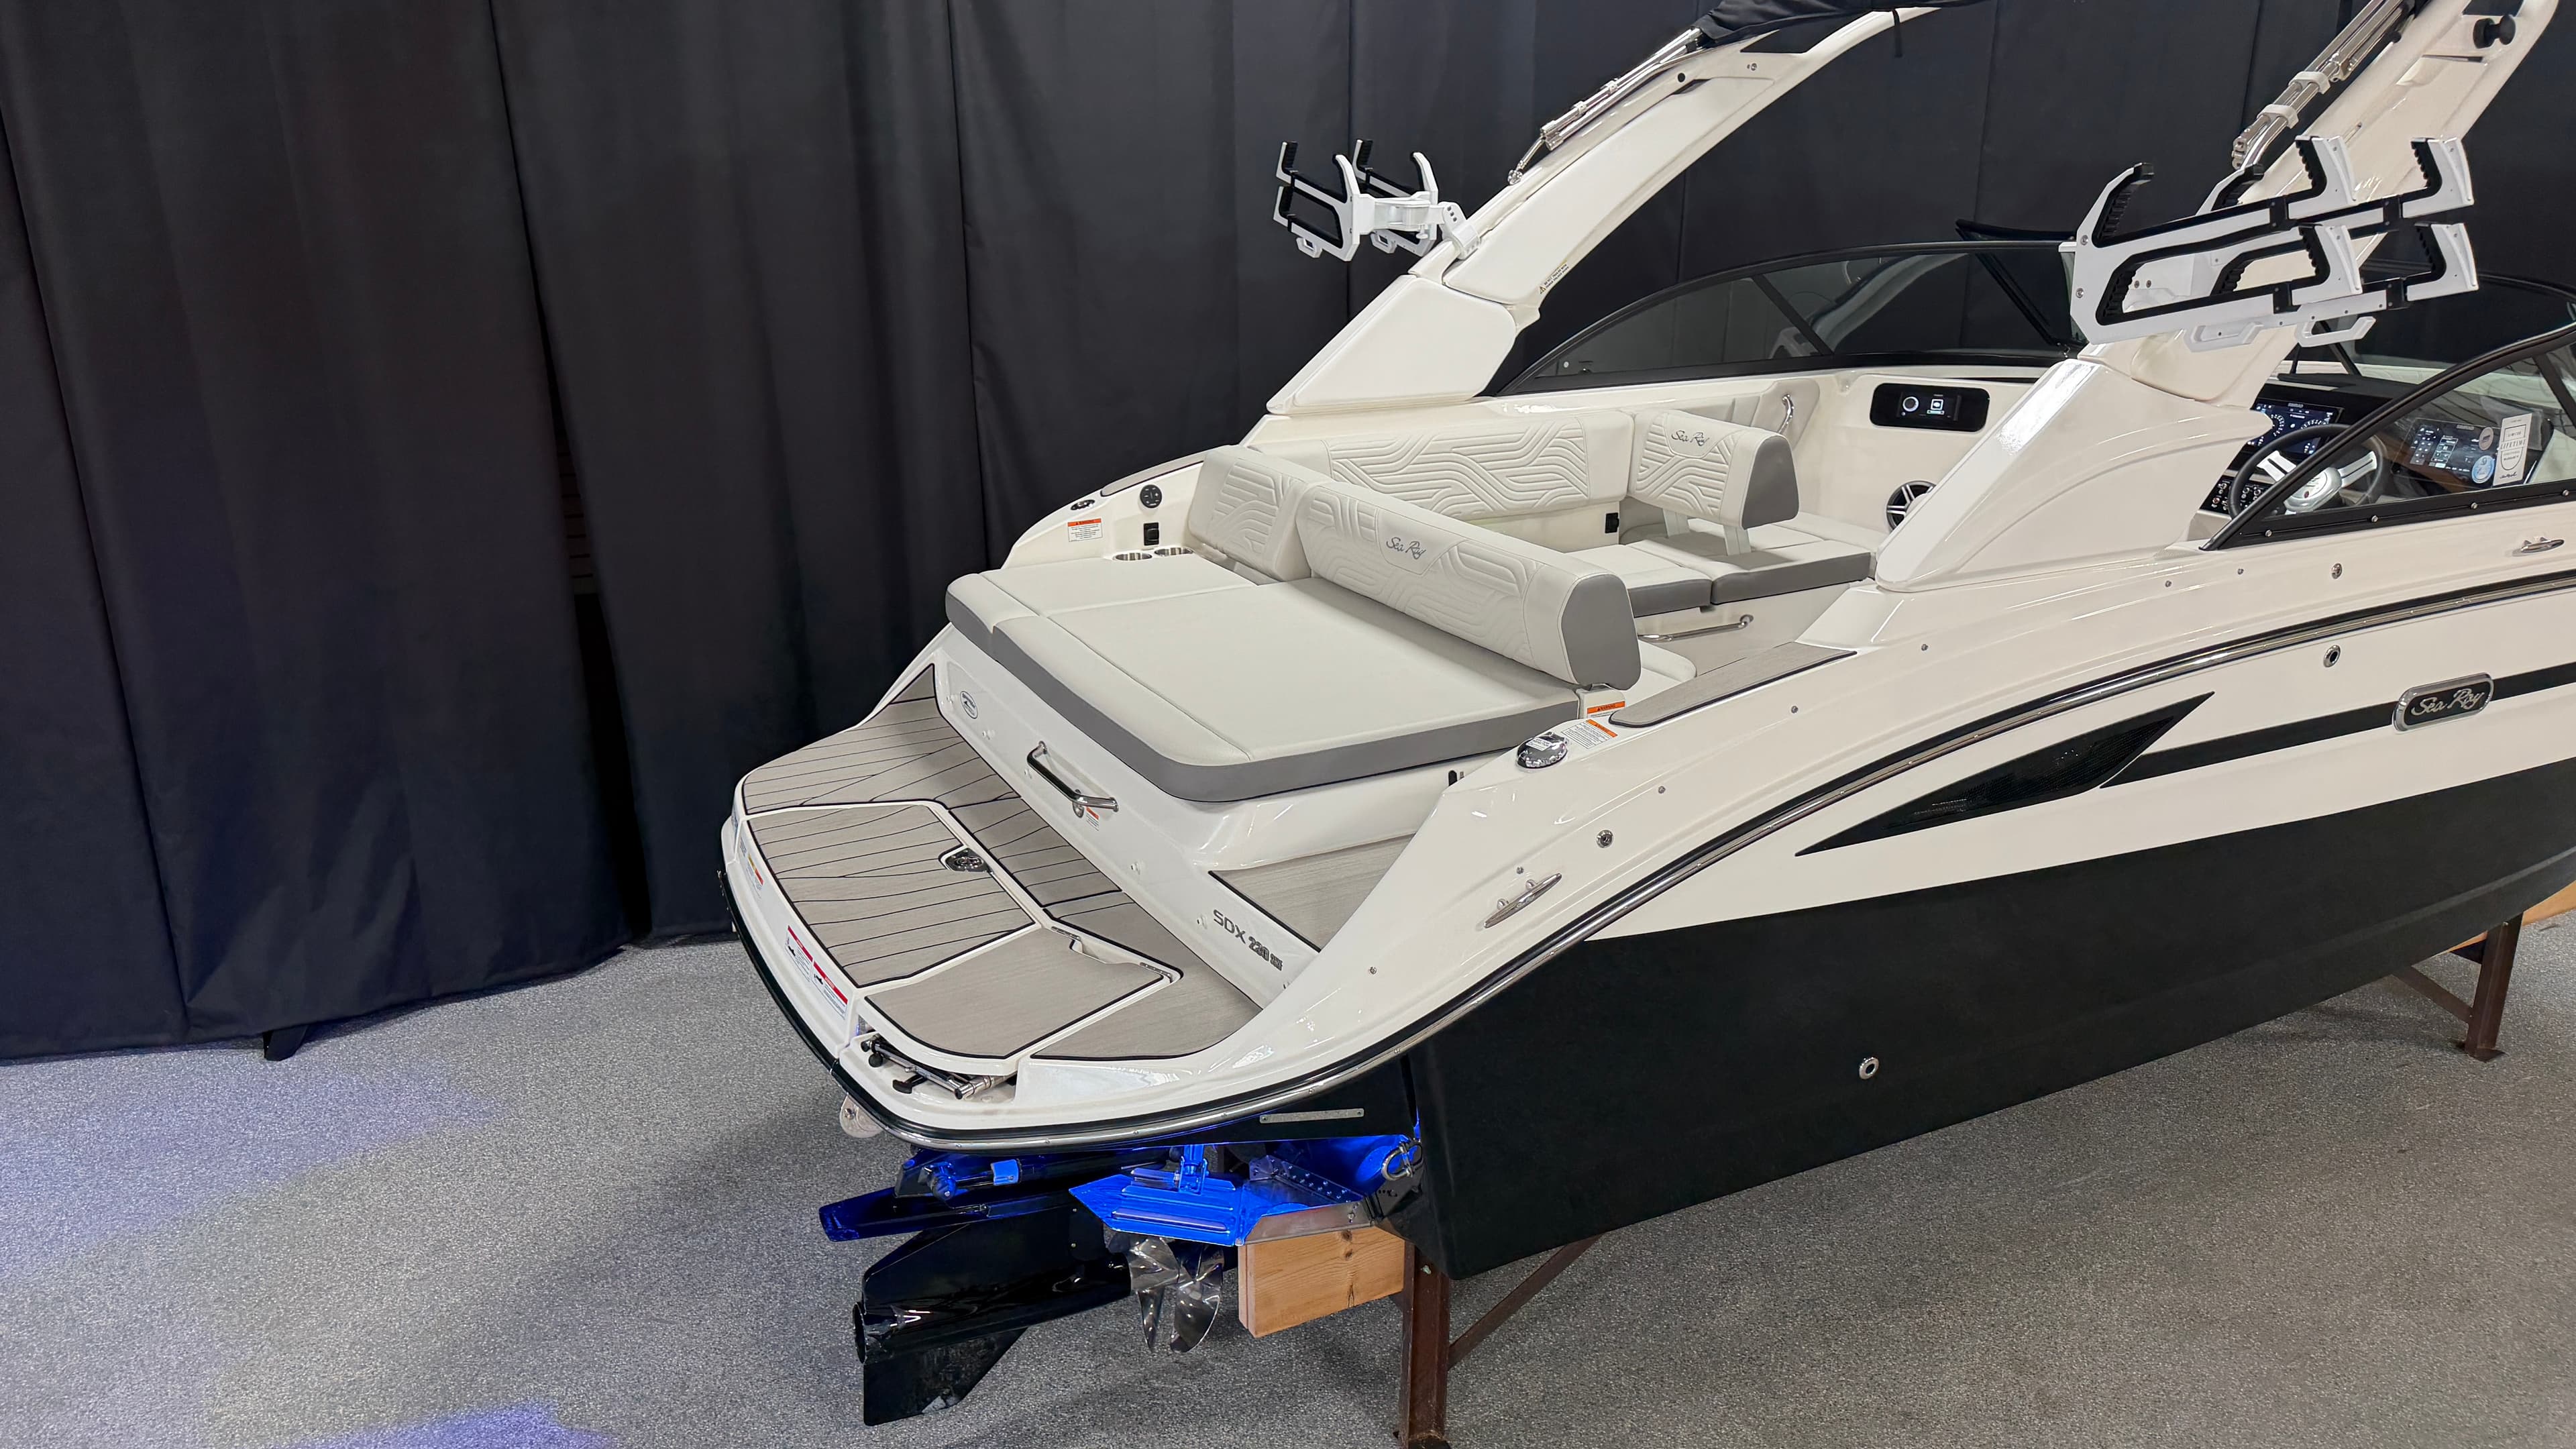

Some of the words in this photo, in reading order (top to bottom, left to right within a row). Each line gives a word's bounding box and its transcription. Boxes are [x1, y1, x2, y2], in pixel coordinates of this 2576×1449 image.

[1671, 430, 1689, 442] Sea
[1690, 432, 1710, 446] Ray
[1386, 537, 1405, 551] Sea
[1405, 541, 1426, 559] Ray
[2411, 697, 2448, 716] Sea
[2447, 688, 2485, 710] Ray
[1213, 909, 1246, 945] SDX
